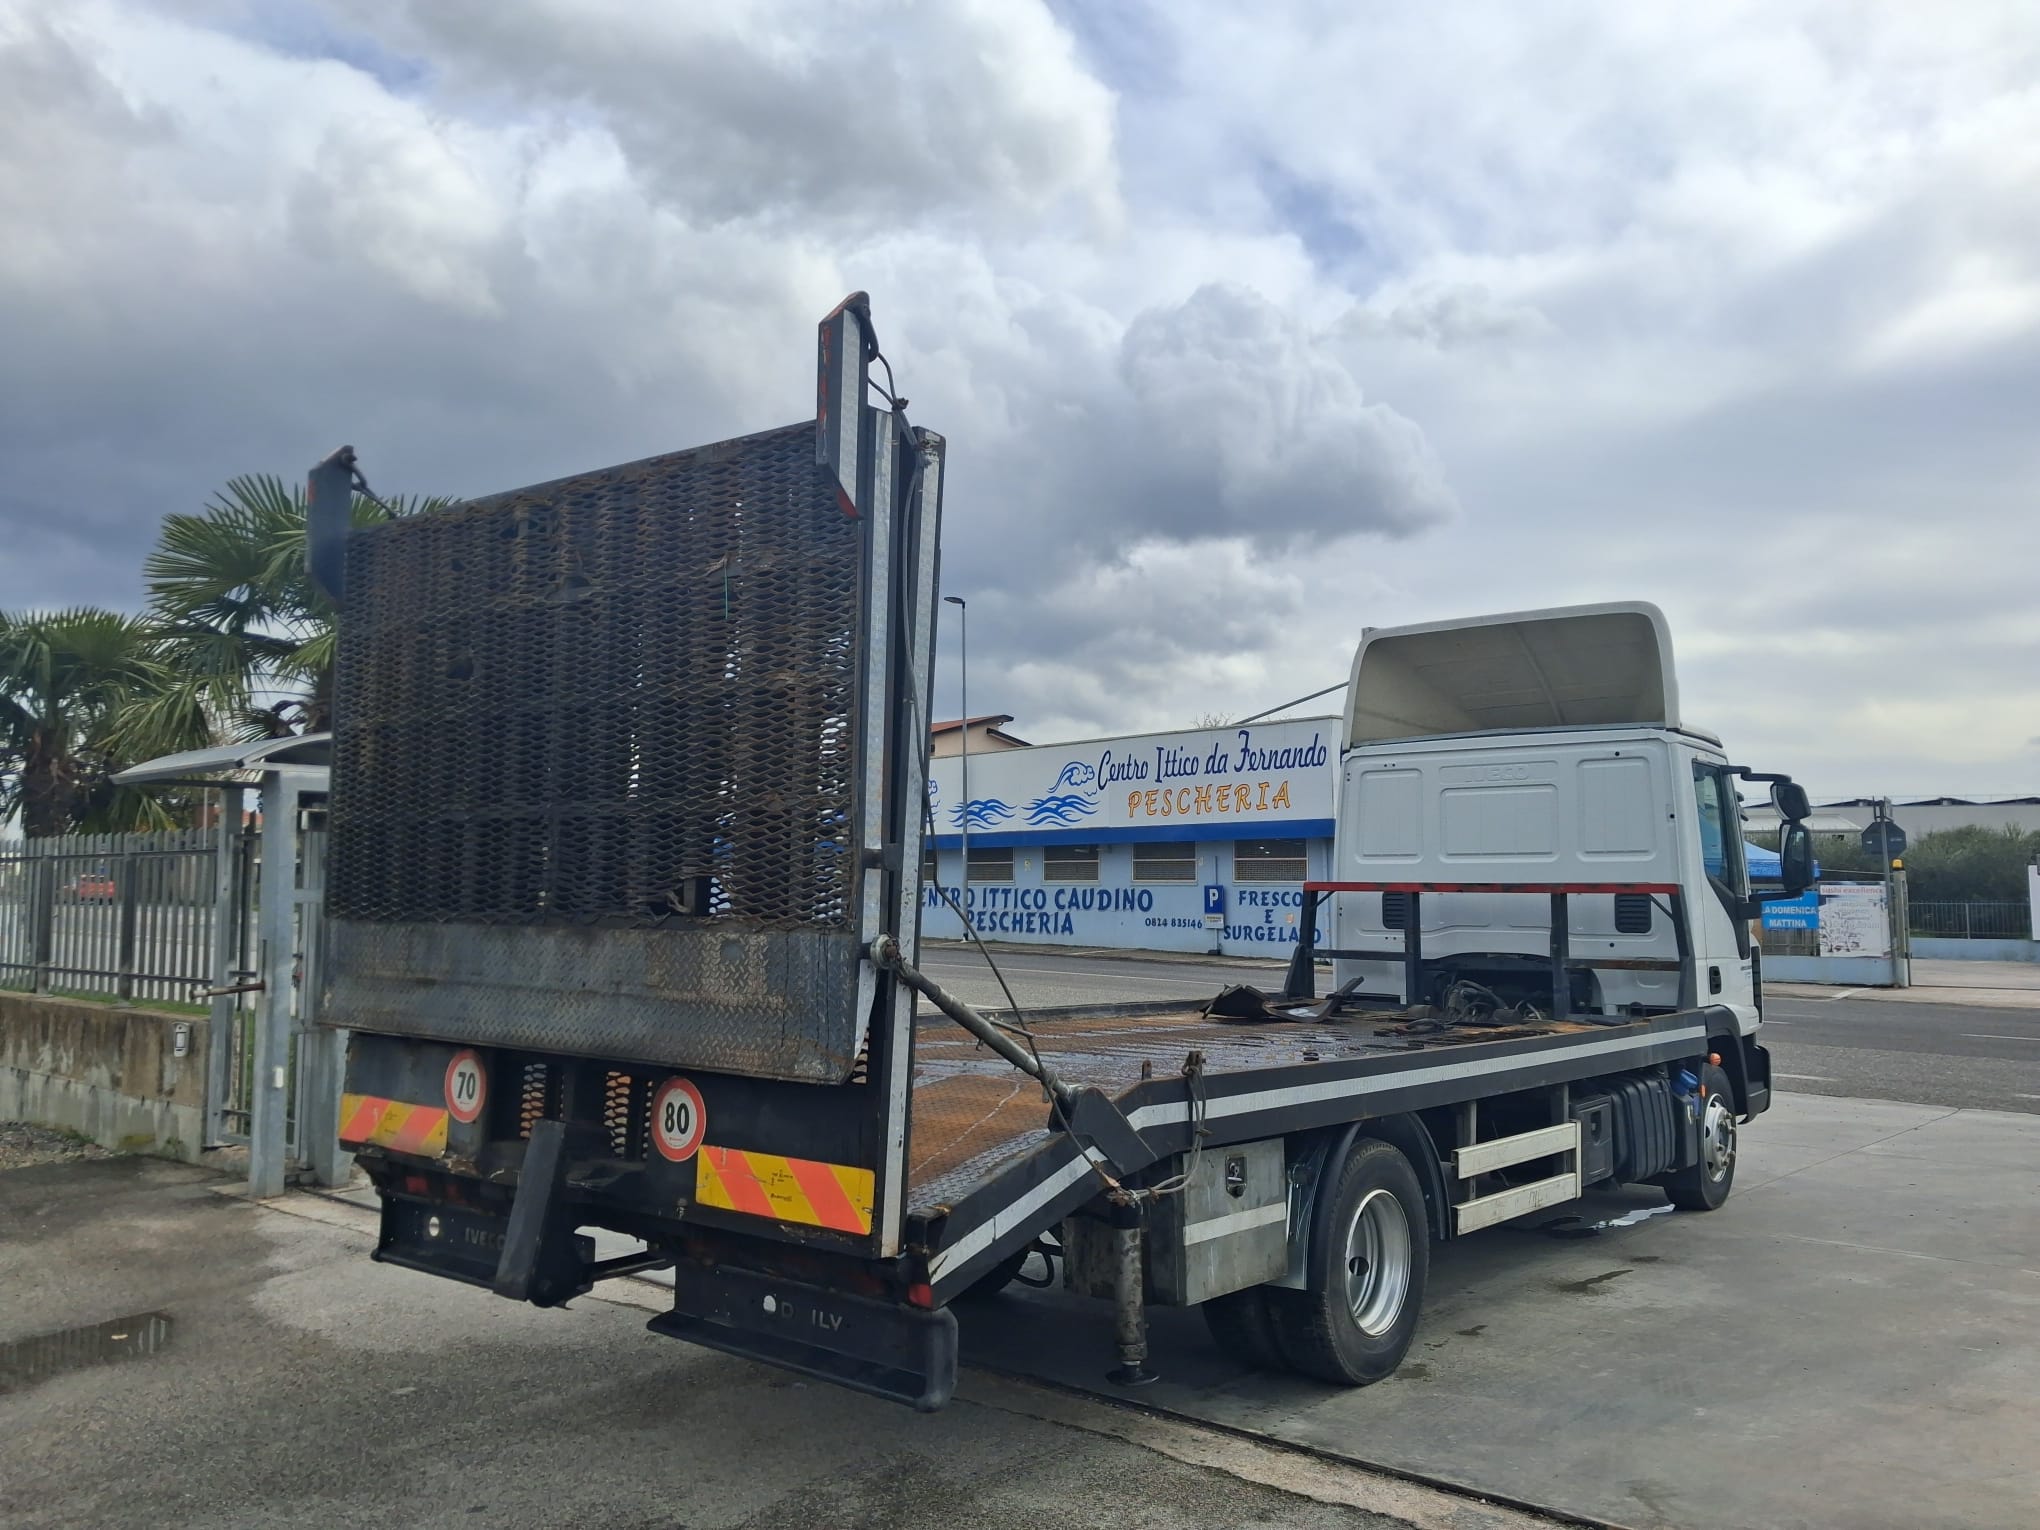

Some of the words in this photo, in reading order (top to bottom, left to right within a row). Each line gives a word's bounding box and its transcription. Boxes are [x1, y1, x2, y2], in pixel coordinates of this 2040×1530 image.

[1097, 749, 1148, 791] Centro
[1155, 745, 1199, 783] Ittico
[1204, 742, 1228, 775] da
[1234, 729, 1327, 773] Fernando
[1128, 780, 1291, 818] PESCHERIA
[983, 887, 1047, 910] ITTICO
[1054, 887, 1153, 912] CAUDINO
[1209, 888, 1219, 908] P
[1238, 890, 1304, 907] FRESCO
[1264, 909, 1274, 924] E
[1772, 906, 1817, 915] DOMENICA
[967, 910, 1074, 935] PESCHERIA
[1145, 917, 1168, 928] 0824
[1171, 918, 1203, 929] 835146
[1769, 919, 1808, 928] MATTINA
[1224, 925, 1322, 944] SURGELAO
[457, 1071, 476, 1100] 70
[665, 1102, 690, 1134] 80
